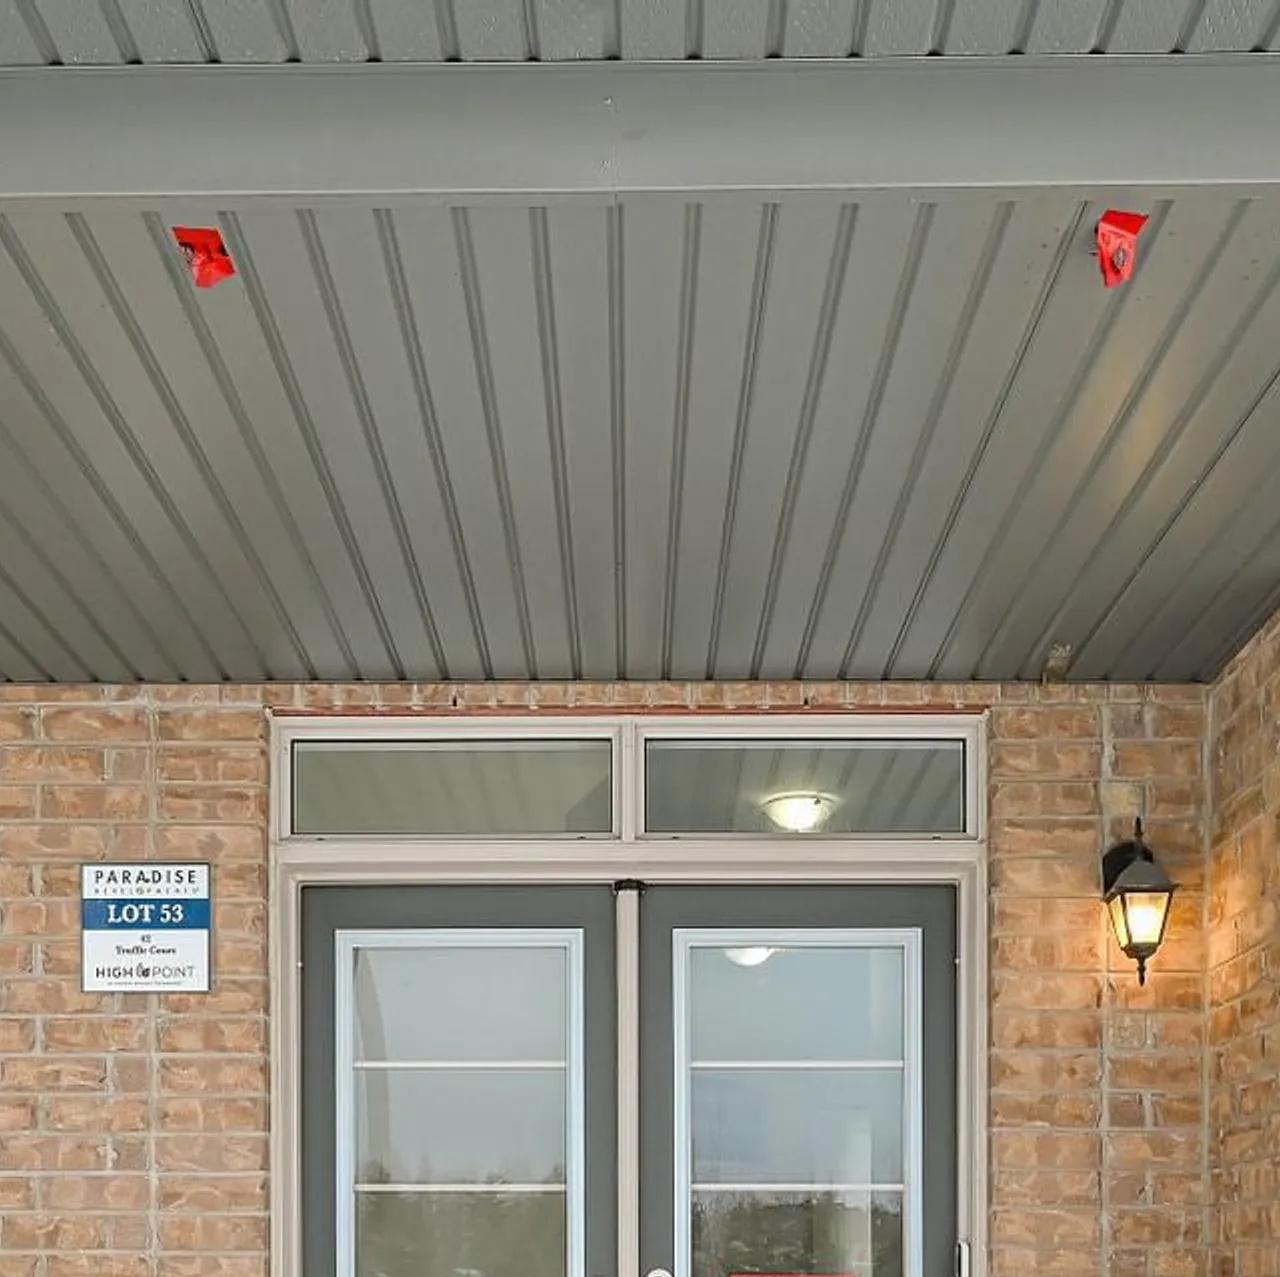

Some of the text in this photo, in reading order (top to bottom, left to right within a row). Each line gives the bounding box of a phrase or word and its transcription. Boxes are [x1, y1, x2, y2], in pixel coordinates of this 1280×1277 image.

[94, 870, 197, 884] PARADISE
[107, 904, 185, 924] LOT 53
[95, 966, 195, 979] HIGH POINT
